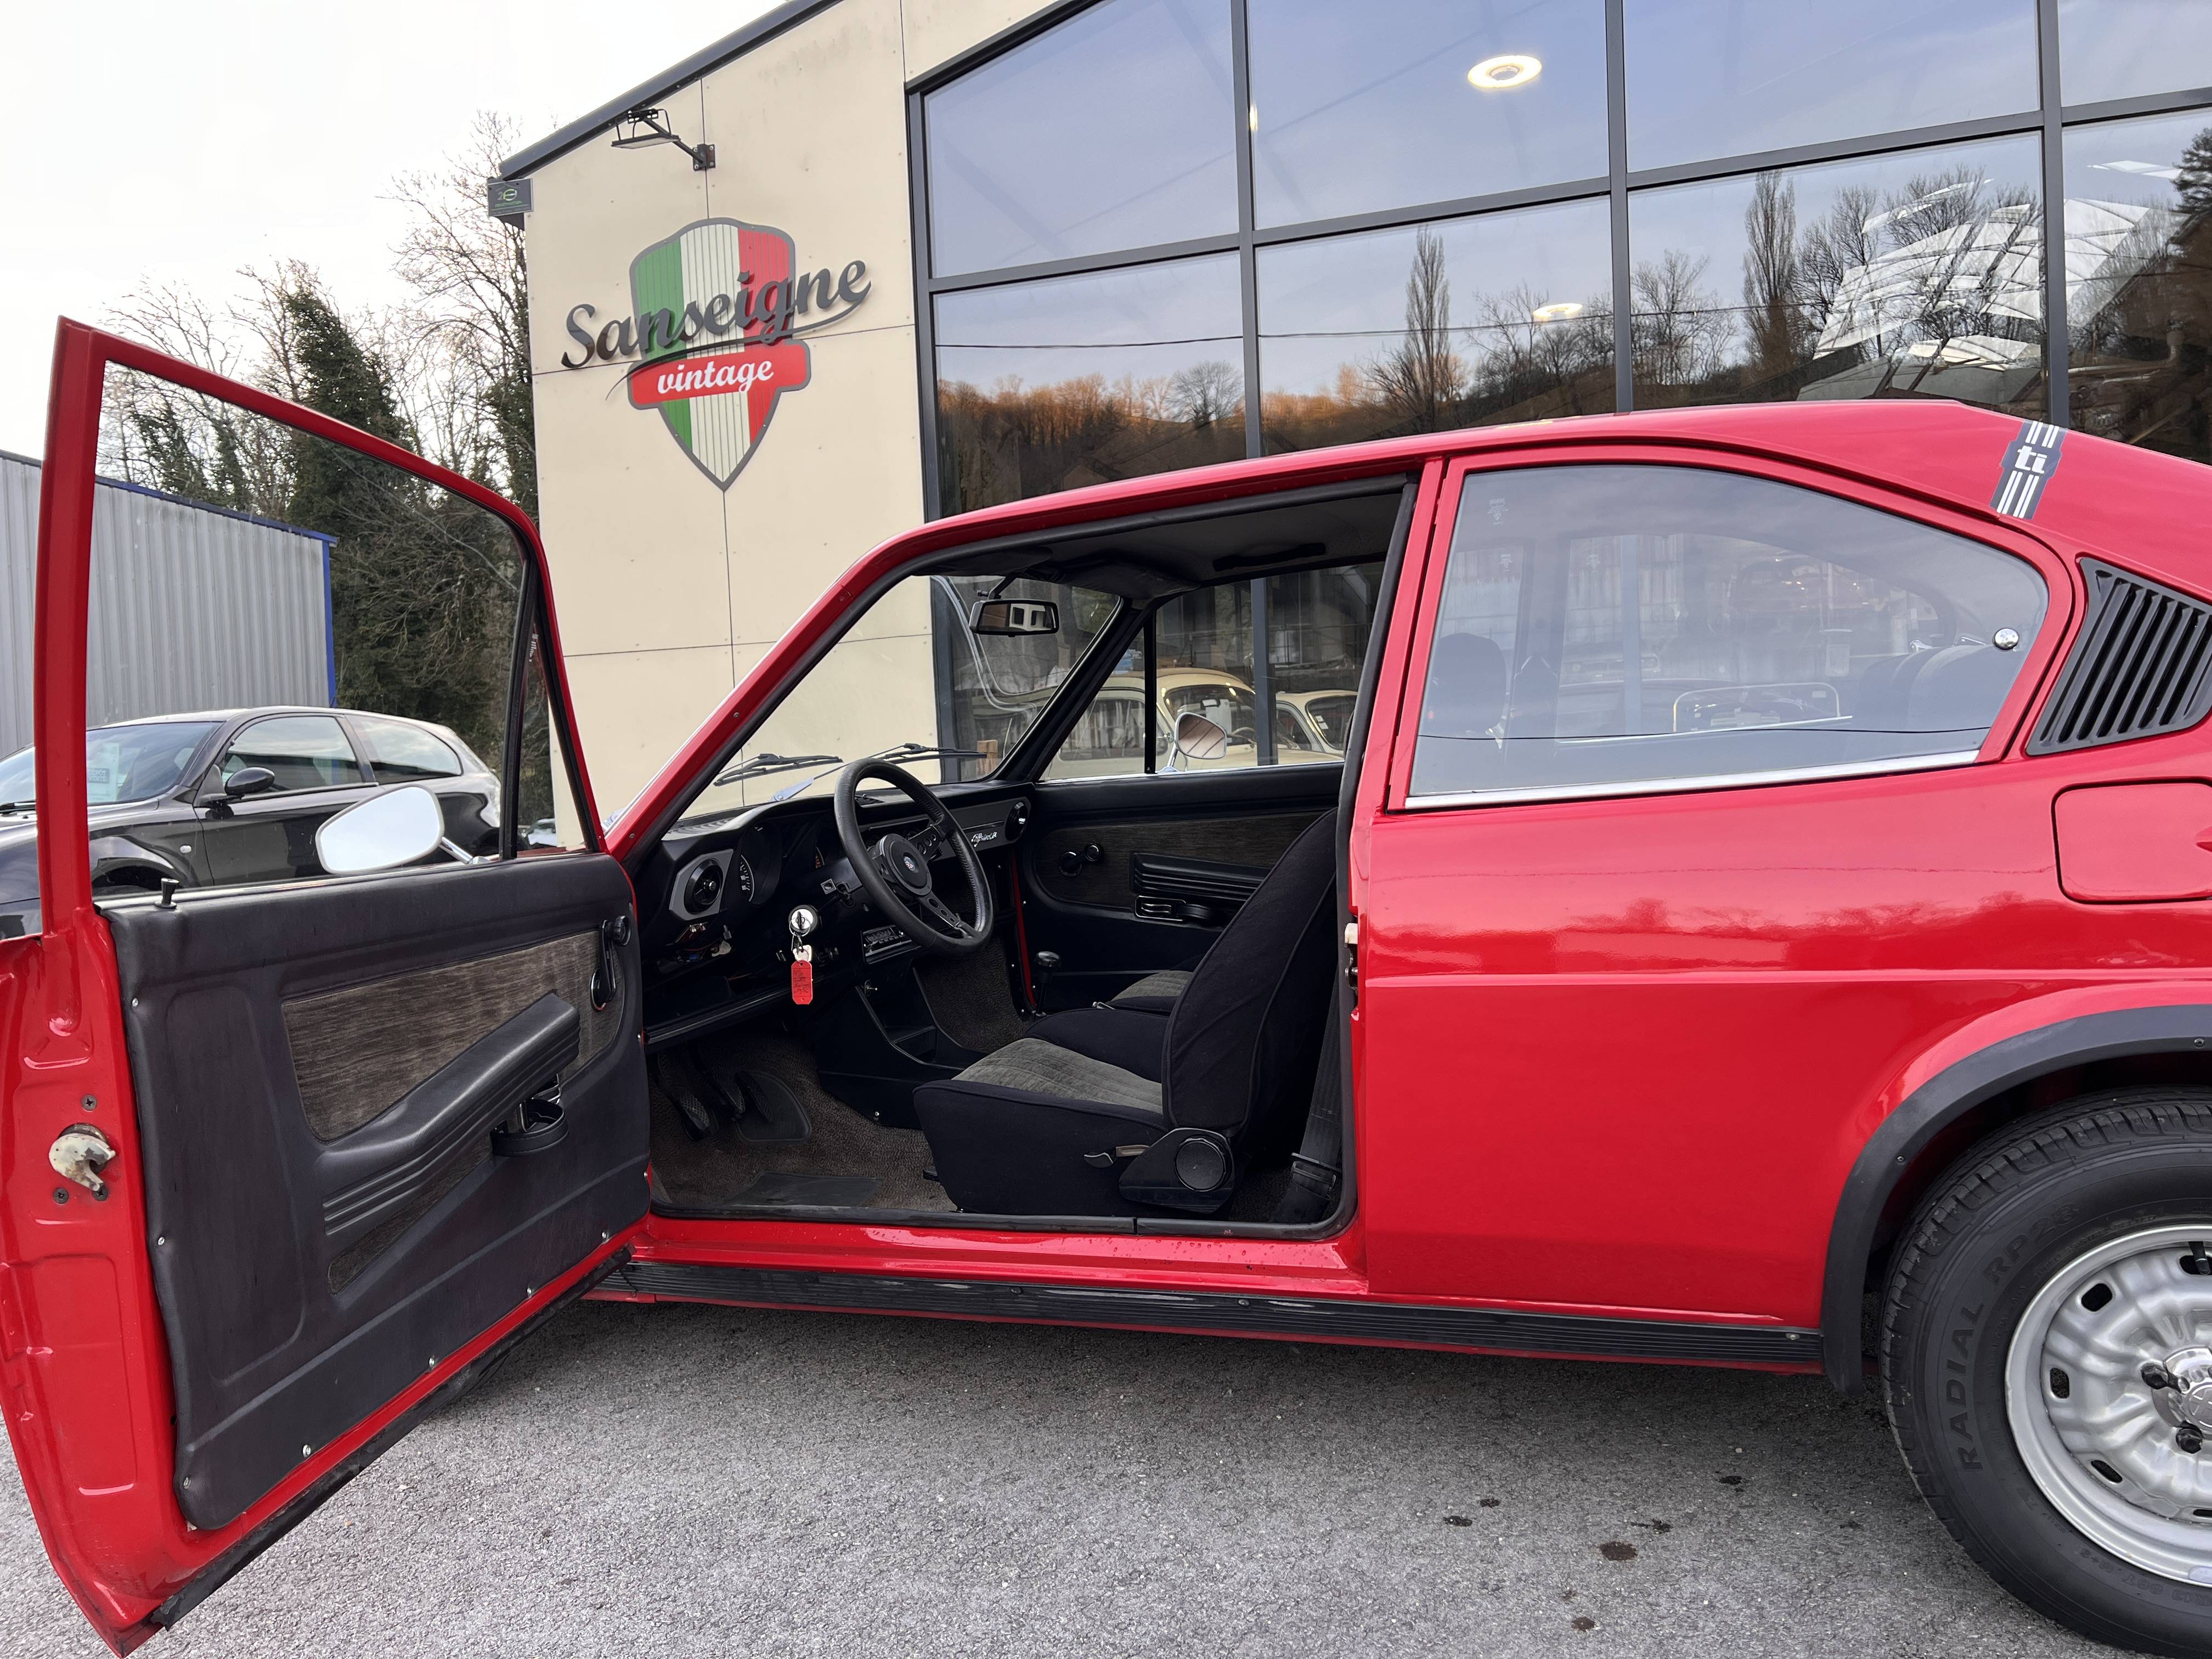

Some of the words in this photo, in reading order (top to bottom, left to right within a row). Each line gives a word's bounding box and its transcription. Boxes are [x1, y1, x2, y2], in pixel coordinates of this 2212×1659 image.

[561, 261, 871, 369] Sanseigne
[657, 361, 774, 394] vintage
[2015, 445, 2047, 474] ti
[1946, 1301, 1985, 1472] RADIAL
